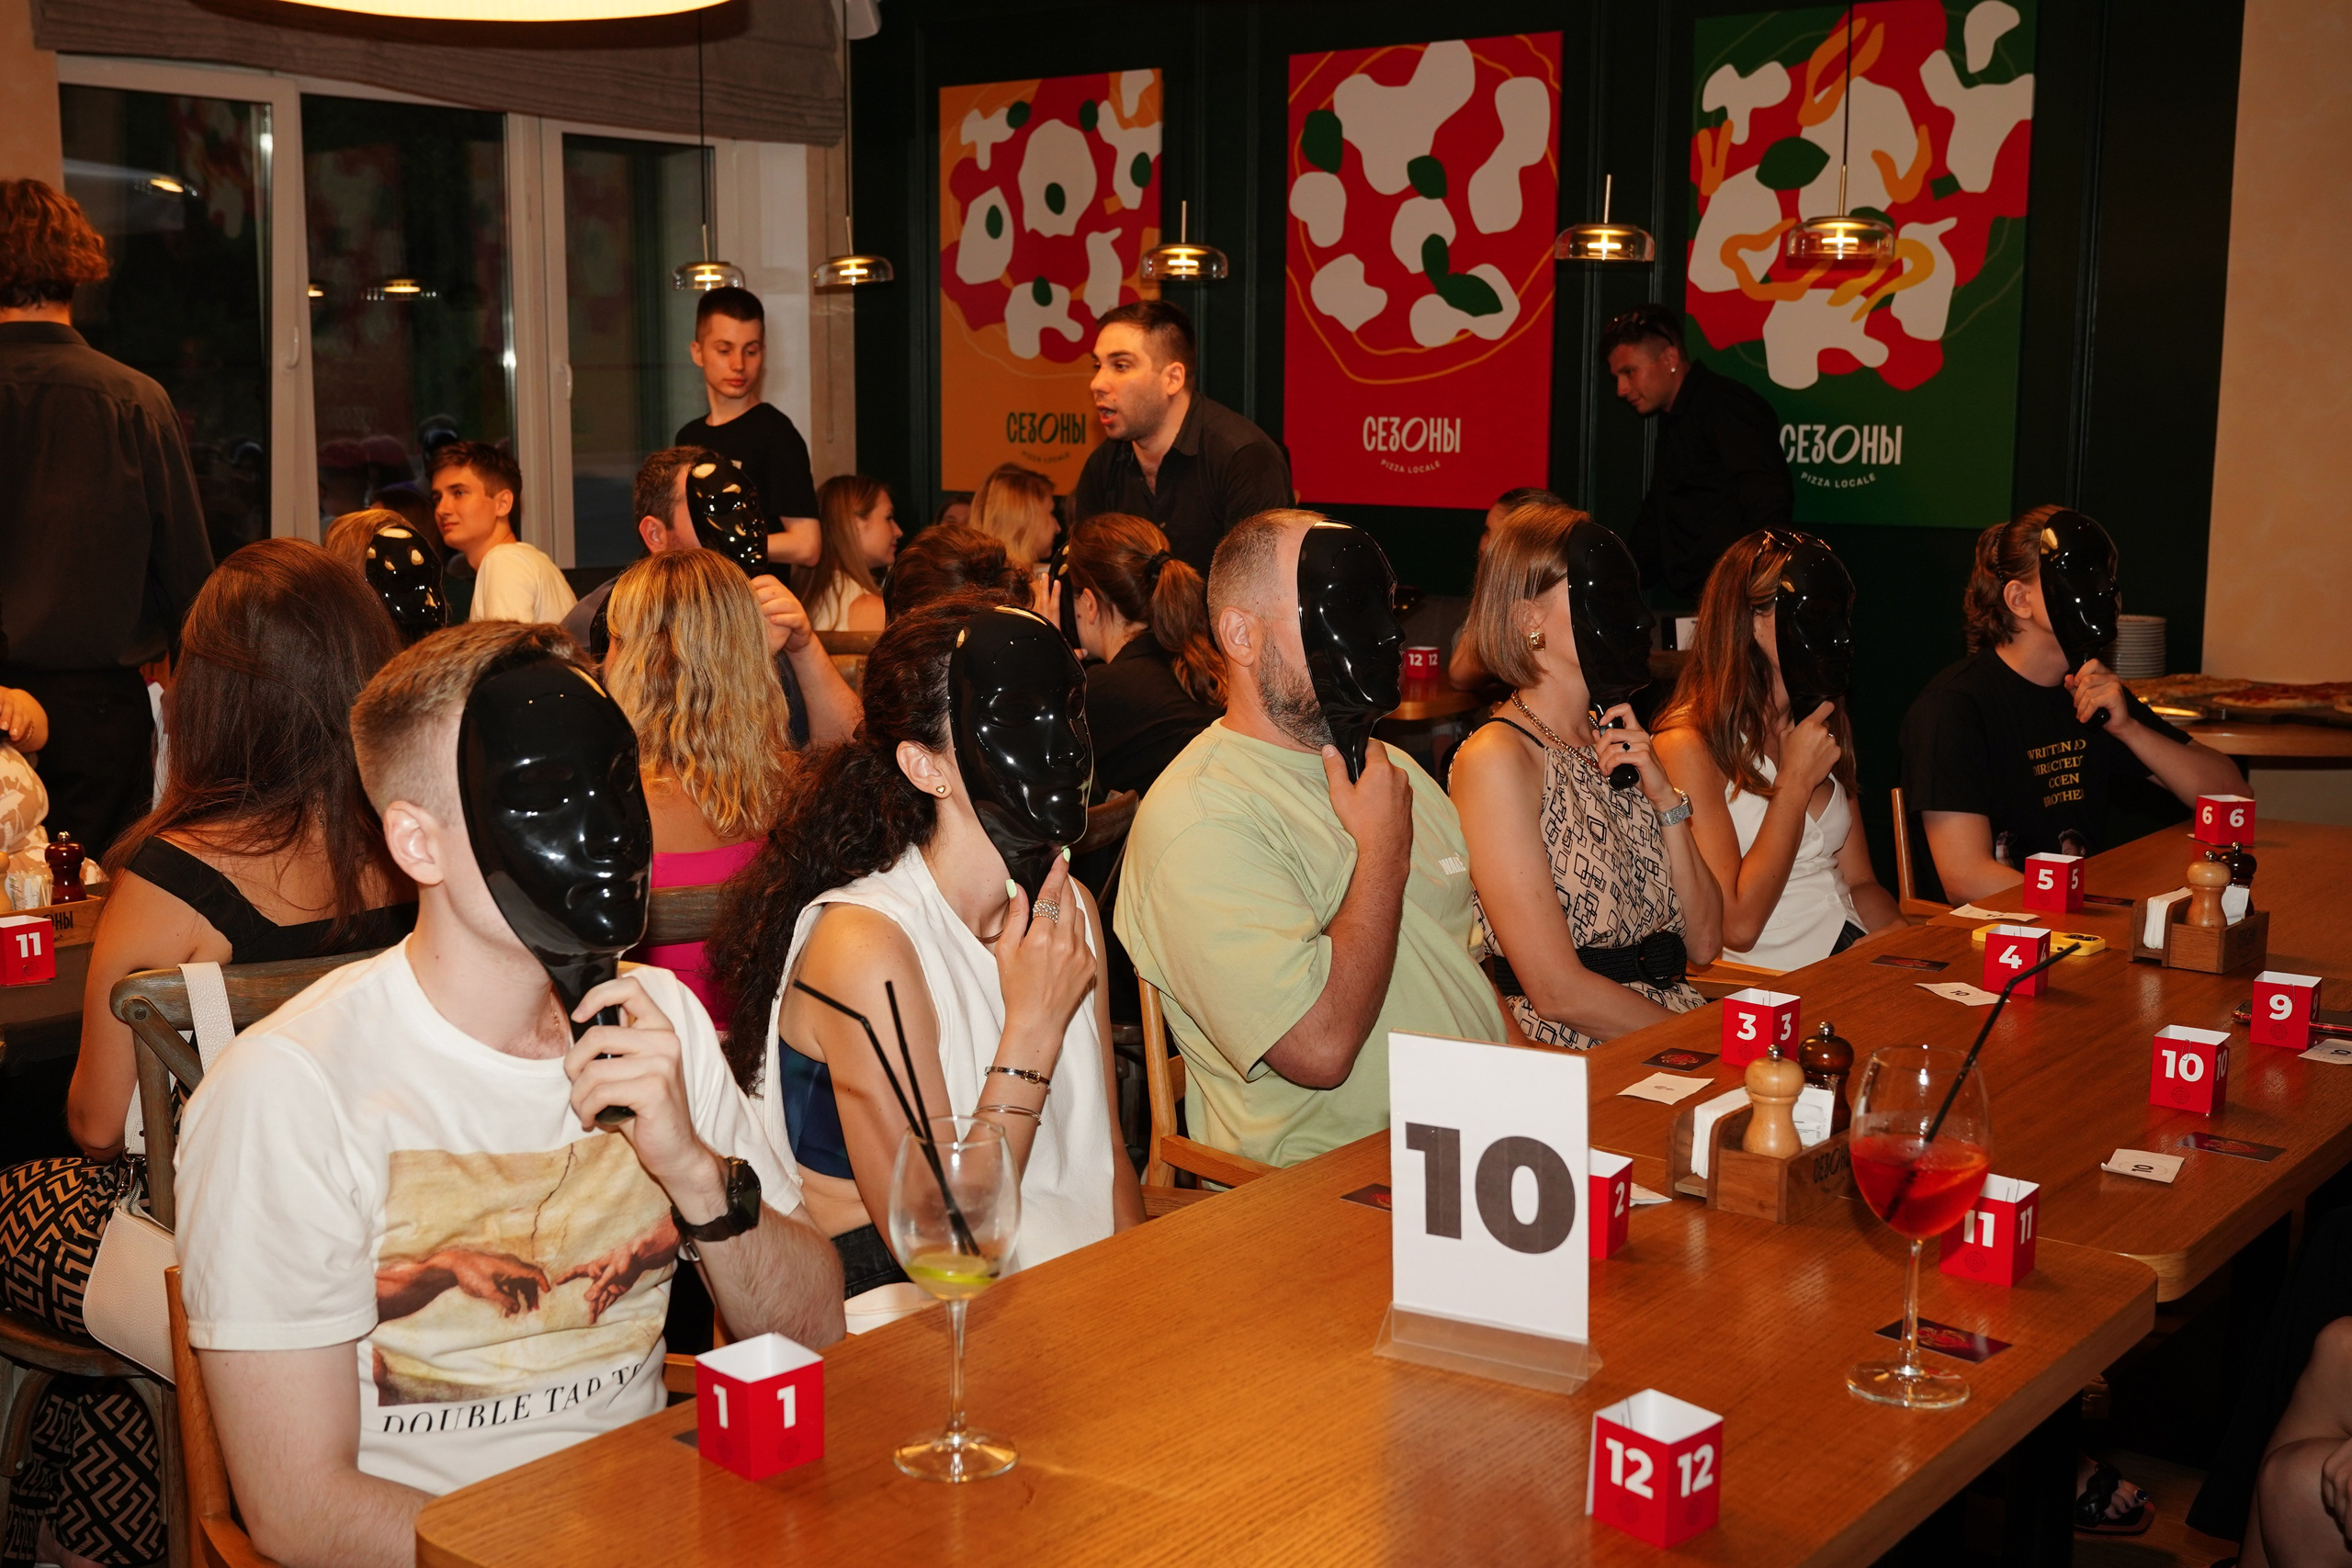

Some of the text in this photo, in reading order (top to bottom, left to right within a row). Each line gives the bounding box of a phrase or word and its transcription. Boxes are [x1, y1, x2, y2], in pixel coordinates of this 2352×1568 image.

[1007, 412, 1086, 445] СЕЗОНЫ
[1363, 416, 1461, 453] СЕЗОНЫ
[1779, 423, 1903, 465] СЕЗОНЫ
[1381, 458, 1441, 474] PIZZA LOCALE
[1801, 471, 1876, 488] PIZZA LOCALE
[1408, 653, 1423, 667] 12
[1428, 653, 1438, 666] 12
[2049, 773, 2079, 789] COEN
[2201, 806, 2213, 825] 6
[2229, 807, 2245, 828] 6
[2036, 868, 2054, 890] 5
[2071, 868, 2080, 890] 5
[16, 931, 41, 958] 11
[1998, 944, 2023, 970] 4
[2268, 993, 2293, 1021] 9
[1736, 1012, 1757, 1041] 3
[1780, 1012, 1792, 1041] 3
[2161, 1049, 2204, 1082] 10
[2216, 1048, 2228, 1080] 10
[2132, 1164, 2154, 1173] 10
[1406, 1121, 1576, 1255] 10
[1614, 1181, 1625, 1218] 2
[1963, 1209, 1996, 1248] 11
[2019, 1204, 2033, 1245] 11
[382, 1393, 533, 1433] DOUBLE
[544, 1377, 601, 1413] TAP
[712, 1383, 729, 1429] 1
[776, 1384, 797, 1429] 1
[1605, 1437, 1655, 1500] 12
[1677, 1443, 1715, 1498] 12
